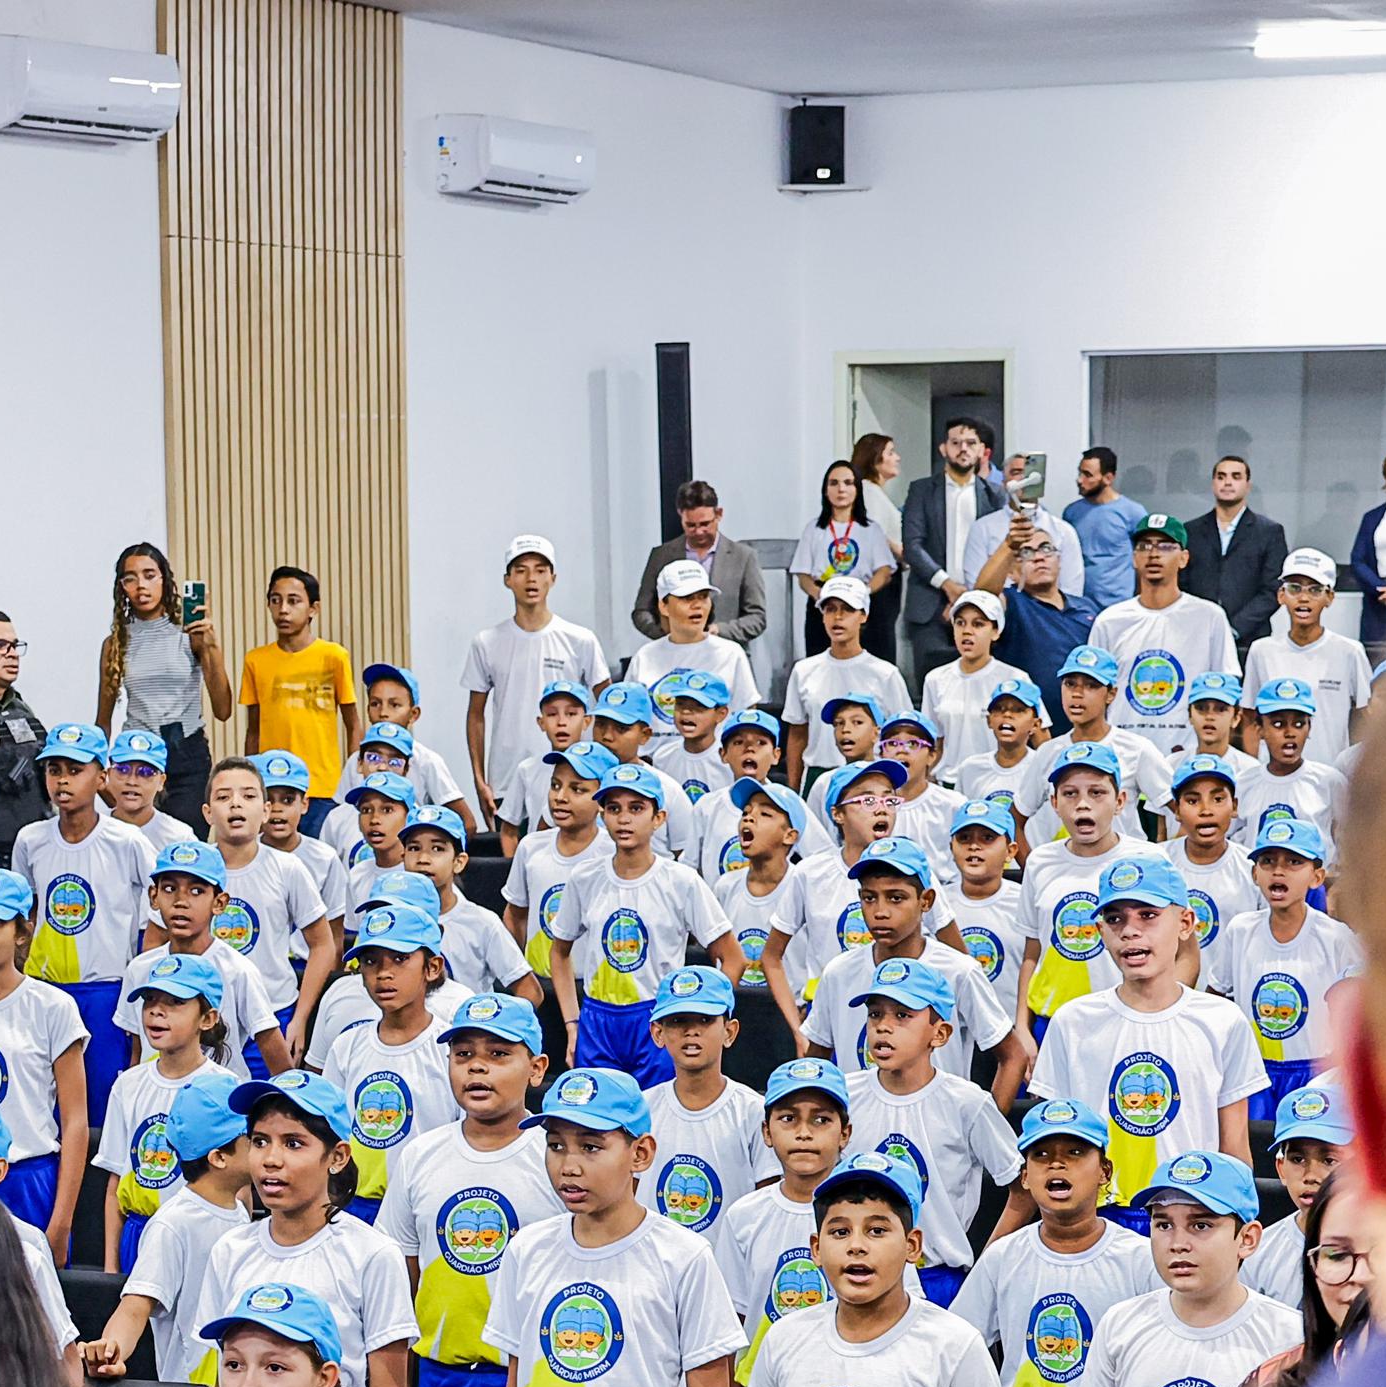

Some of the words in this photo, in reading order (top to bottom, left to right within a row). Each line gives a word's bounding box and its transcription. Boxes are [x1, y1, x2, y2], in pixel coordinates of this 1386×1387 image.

[1124, 1053, 1163, 1067] PROJETO
[1114, 1113, 1153, 1135] GUARDIÃO
[672, 1156, 706, 1169] ROJETO
[457, 1186, 500, 1201] PROJETO
[444, 1250, 483, 1274] GUARDIÃO
[482, 1255, 503, 1272] MIRI
[783, 1249, 811, 1262] PROJE
[547, 1353, 583, 1382] GUARDIÃO
[582, 1360, 611, 1380] MIRIM
